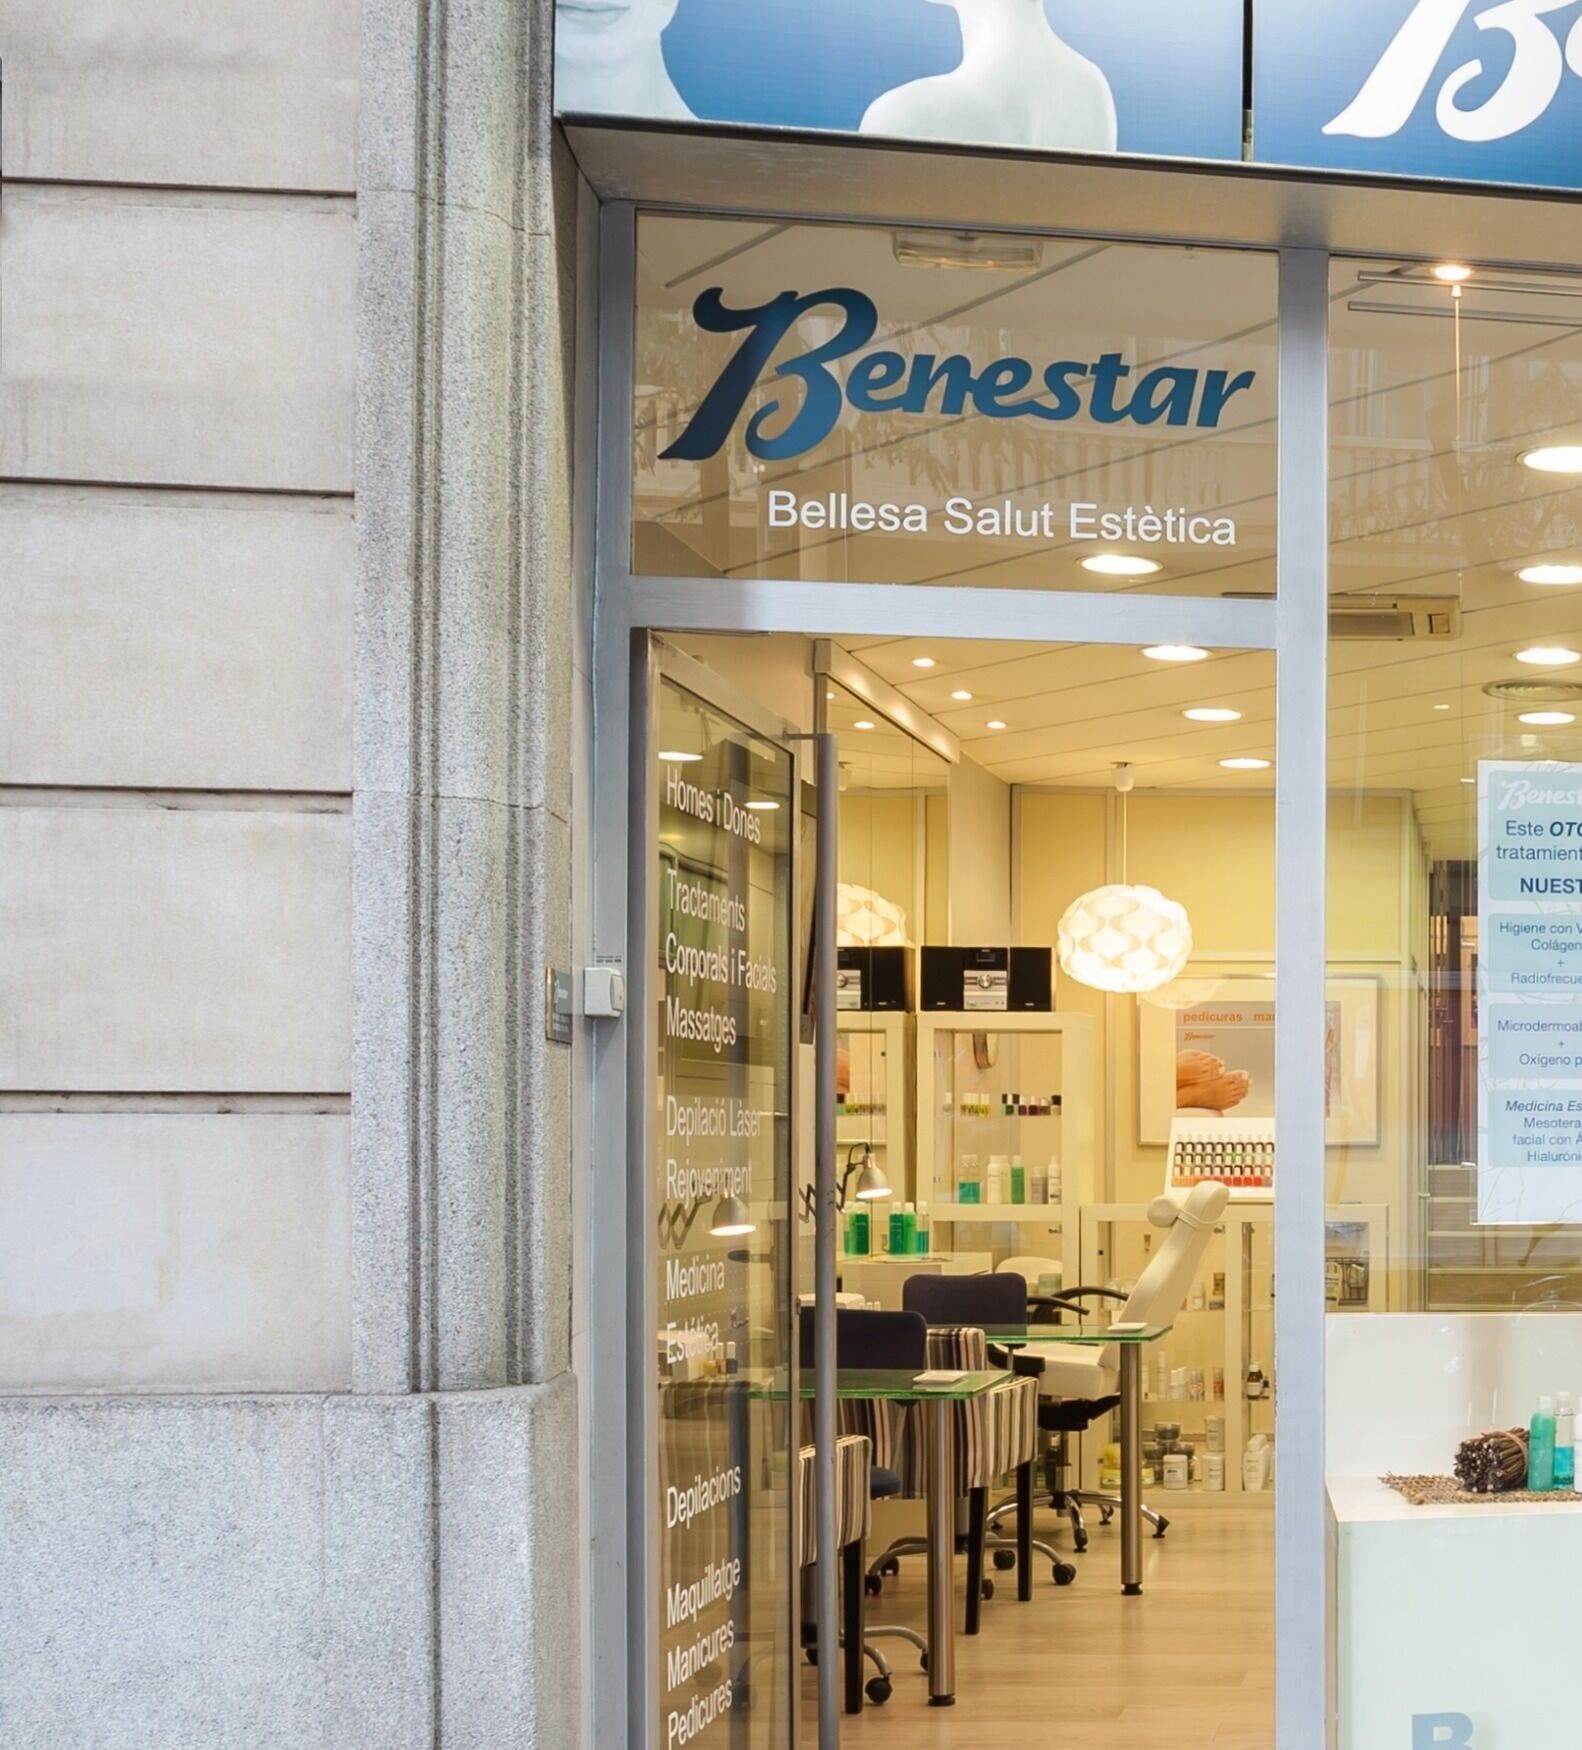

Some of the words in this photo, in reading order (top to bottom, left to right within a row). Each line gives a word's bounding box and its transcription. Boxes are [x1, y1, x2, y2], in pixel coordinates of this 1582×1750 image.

[658, 286, 1257, 462] Benestar
[767, 490, 929, 533] Bellesa
[943, 498, 1054, 540] Salut
[1071, 502, 1237, 546] Estètica
[667, 765, 713, 824] Homes
[715, 789, 720, 827] i
[724, 792, 761, 844] Dones
[1505, 820, 1545, 837] Este
[667, 868, 745, 932] Tractaments
[1500, 922, 1546, 938] Higiene
[1549, 926, 1573, 936] con
[666, 932, 728, 987] Corporals
[731, 950, 735, 985] i
[738, 950, 777, 993] Facials
[667, 995, 737, 1053] Massatges
[1183, 1011, 1243, 1024] pedicuras
[1519, 1053, 1571, 1068] Oxígeno
[667, 1095, 726, 1145] Depilació
[730, 1098, 761, 1137] Làser
[1505, 1100, 1564, 1112] Medicina
[1512, 1133, 1546, 1146] facial
[1549, 1136, 1572, 1146] con
[667, 1158, 752, 1208] Rejoveniment
[667, 1253, 725, 1301] Medicina
[667, 1463, 741, 1530] Depilacions
[667, 1557, 741, 1628] Maquillatge
[667, 1618, 734, 1692] Manicures
[668, 1677, 733, 1750] Pedicures
